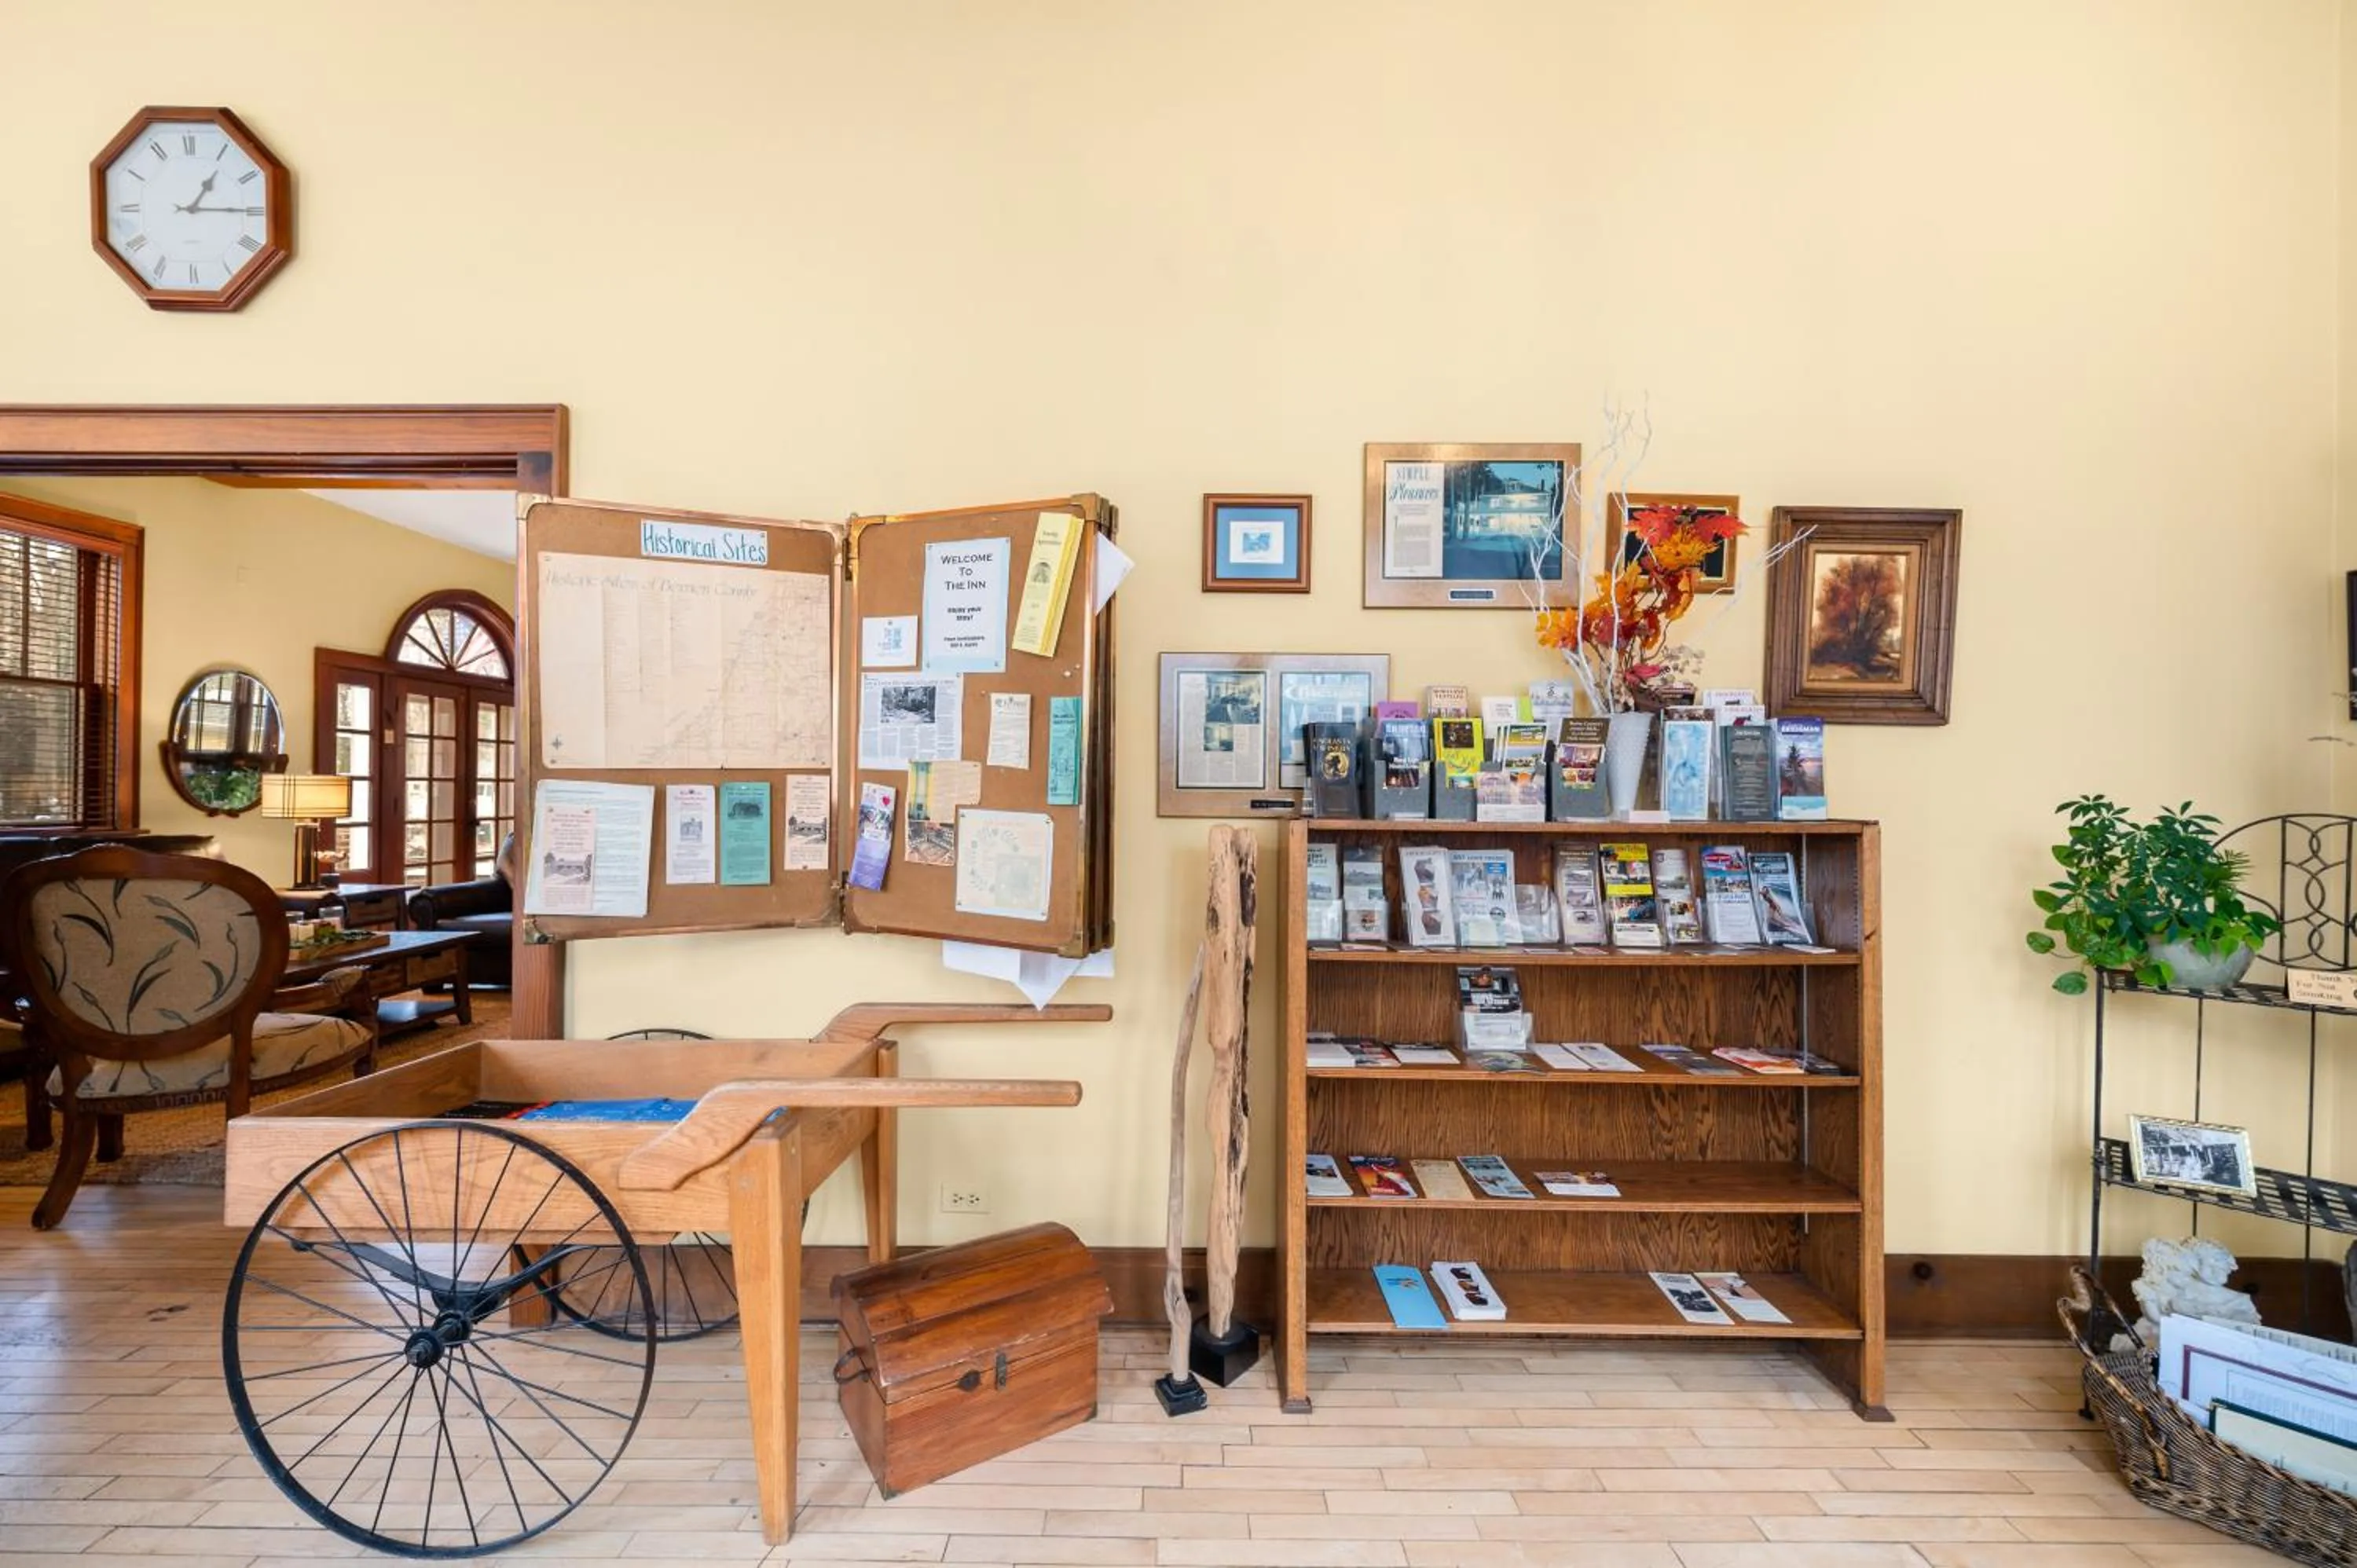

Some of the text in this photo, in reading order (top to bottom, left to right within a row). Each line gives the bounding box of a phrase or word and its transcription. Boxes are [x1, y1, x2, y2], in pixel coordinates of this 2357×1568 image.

[722, 532, 767, 563] Sites
[940, 553, 994, 565] WELCOME
[959, 566, 973, 577] TO
[945, 580, 987, 591] THE INN
